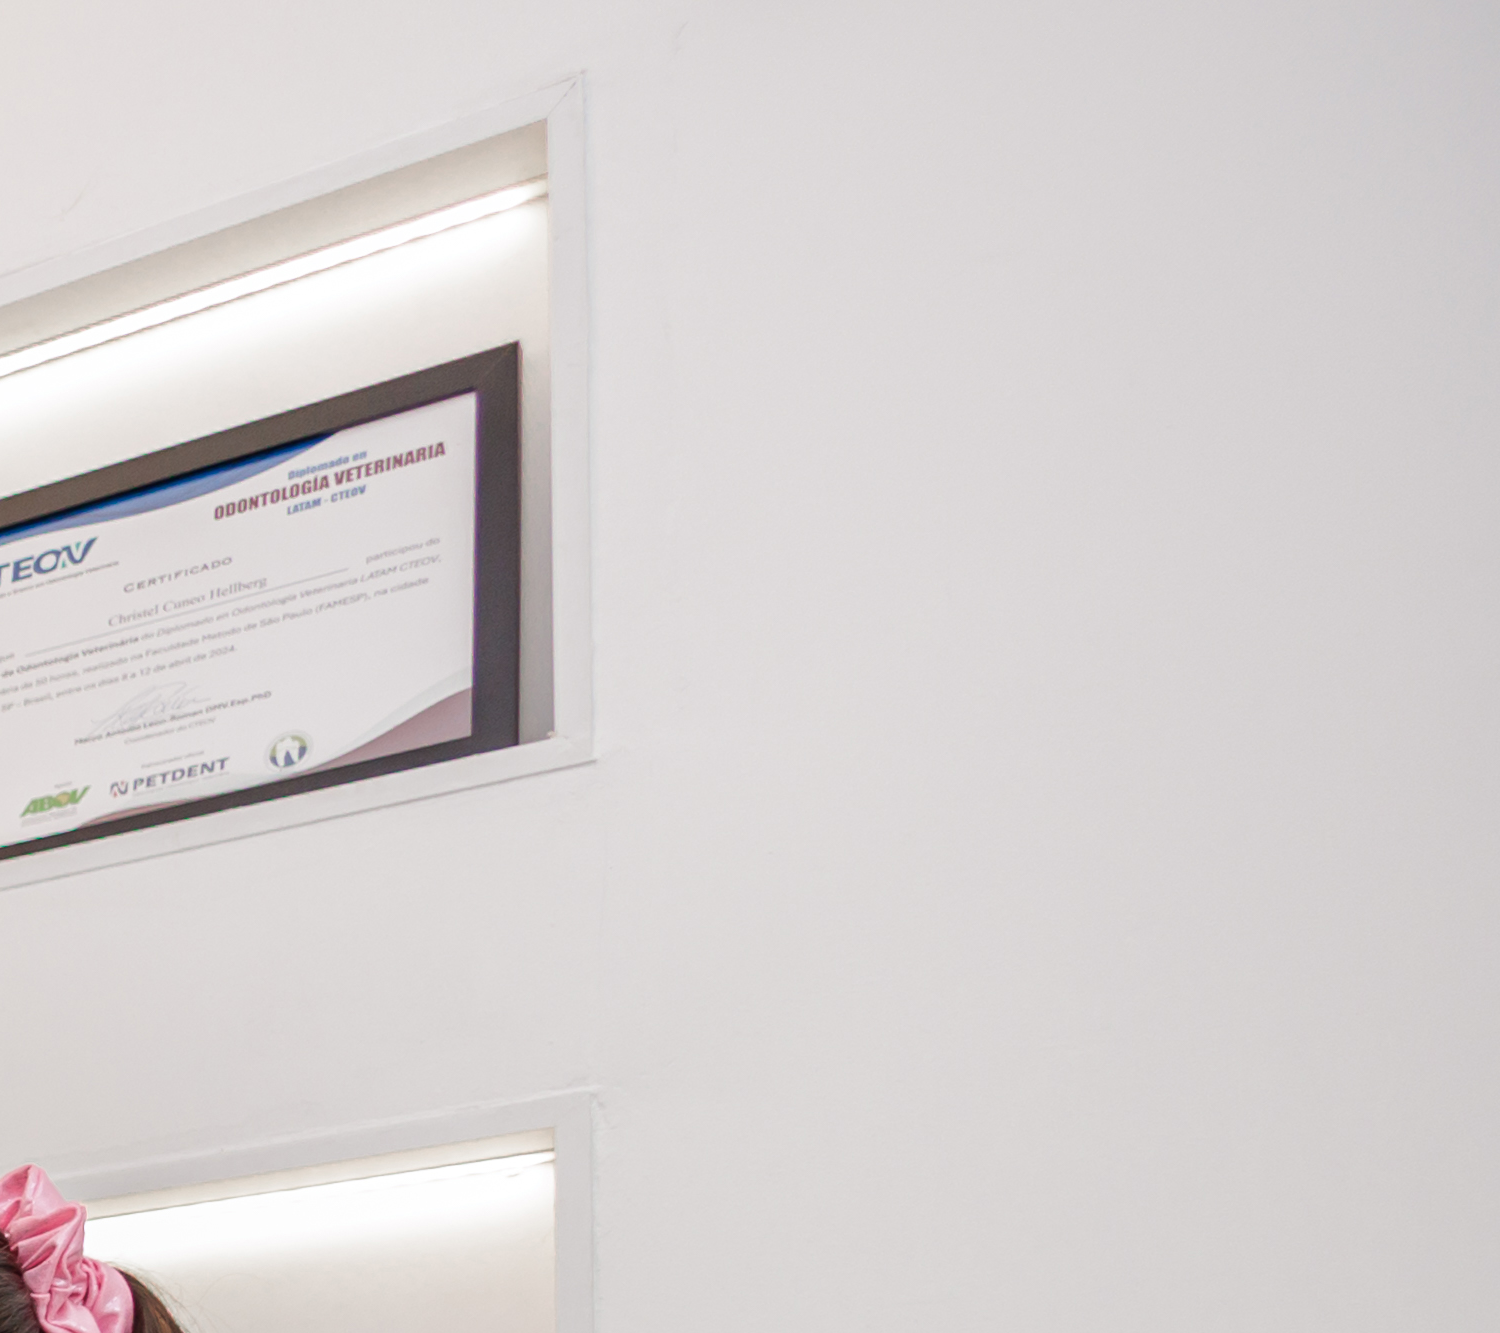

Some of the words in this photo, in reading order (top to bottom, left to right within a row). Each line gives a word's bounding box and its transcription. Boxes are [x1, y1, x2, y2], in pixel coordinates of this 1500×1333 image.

[213, 474, 330, 520] ODONTOLOGÍA
[333, 441, 447, 487] VETERINARIA
[286, 497, 322, 516] LATAM
[330, 484, 367, 503] CTEOV
[122, 556, 233, 594] CERTIFICADO
[107, 603, 159, 628] Christel
[209, 577, 268, 600] Hellberg
[132, 756, 230, 791] PETDENT
